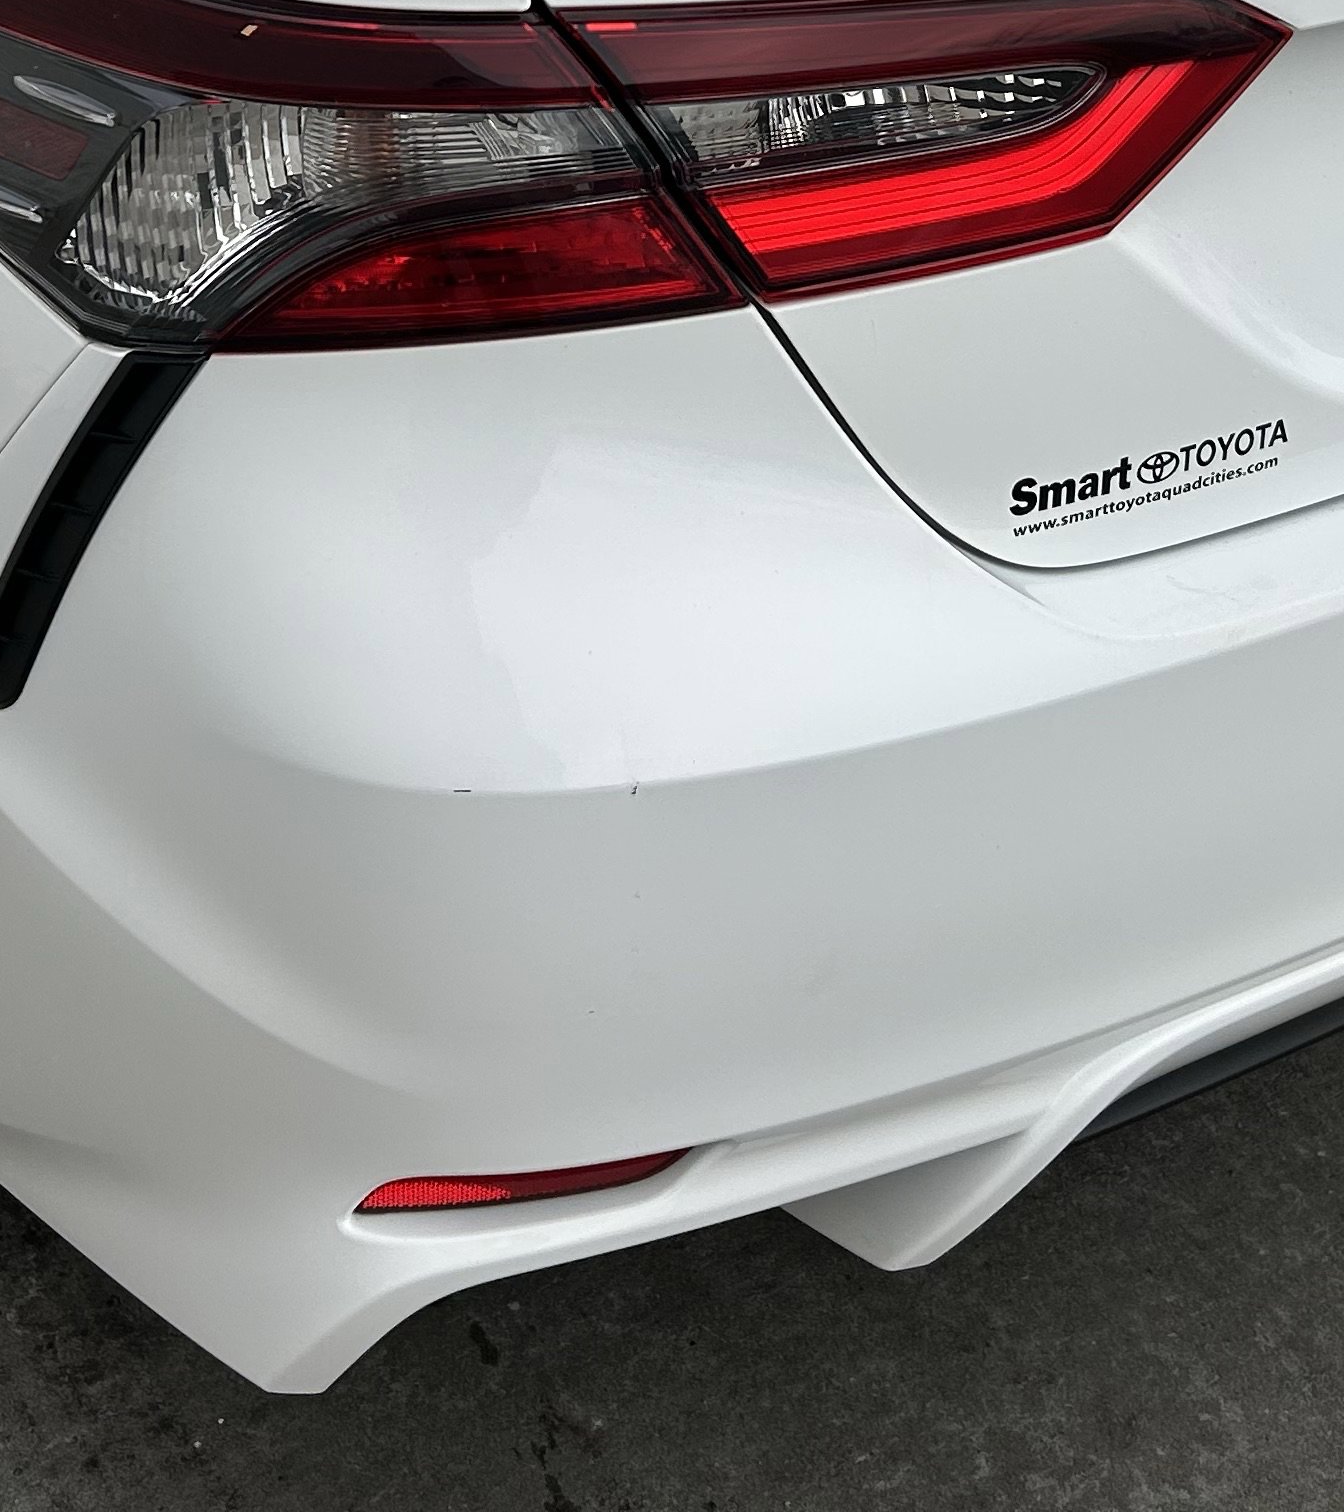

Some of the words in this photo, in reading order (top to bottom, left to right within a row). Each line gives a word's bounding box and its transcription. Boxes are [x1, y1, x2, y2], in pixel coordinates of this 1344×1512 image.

[1009, 455, 1133, 517] Smart
[1179, 418, 1289, 472] TOYOTA
[1012, 456, 1279, 538] www.smarttoyotaquadcities.com
